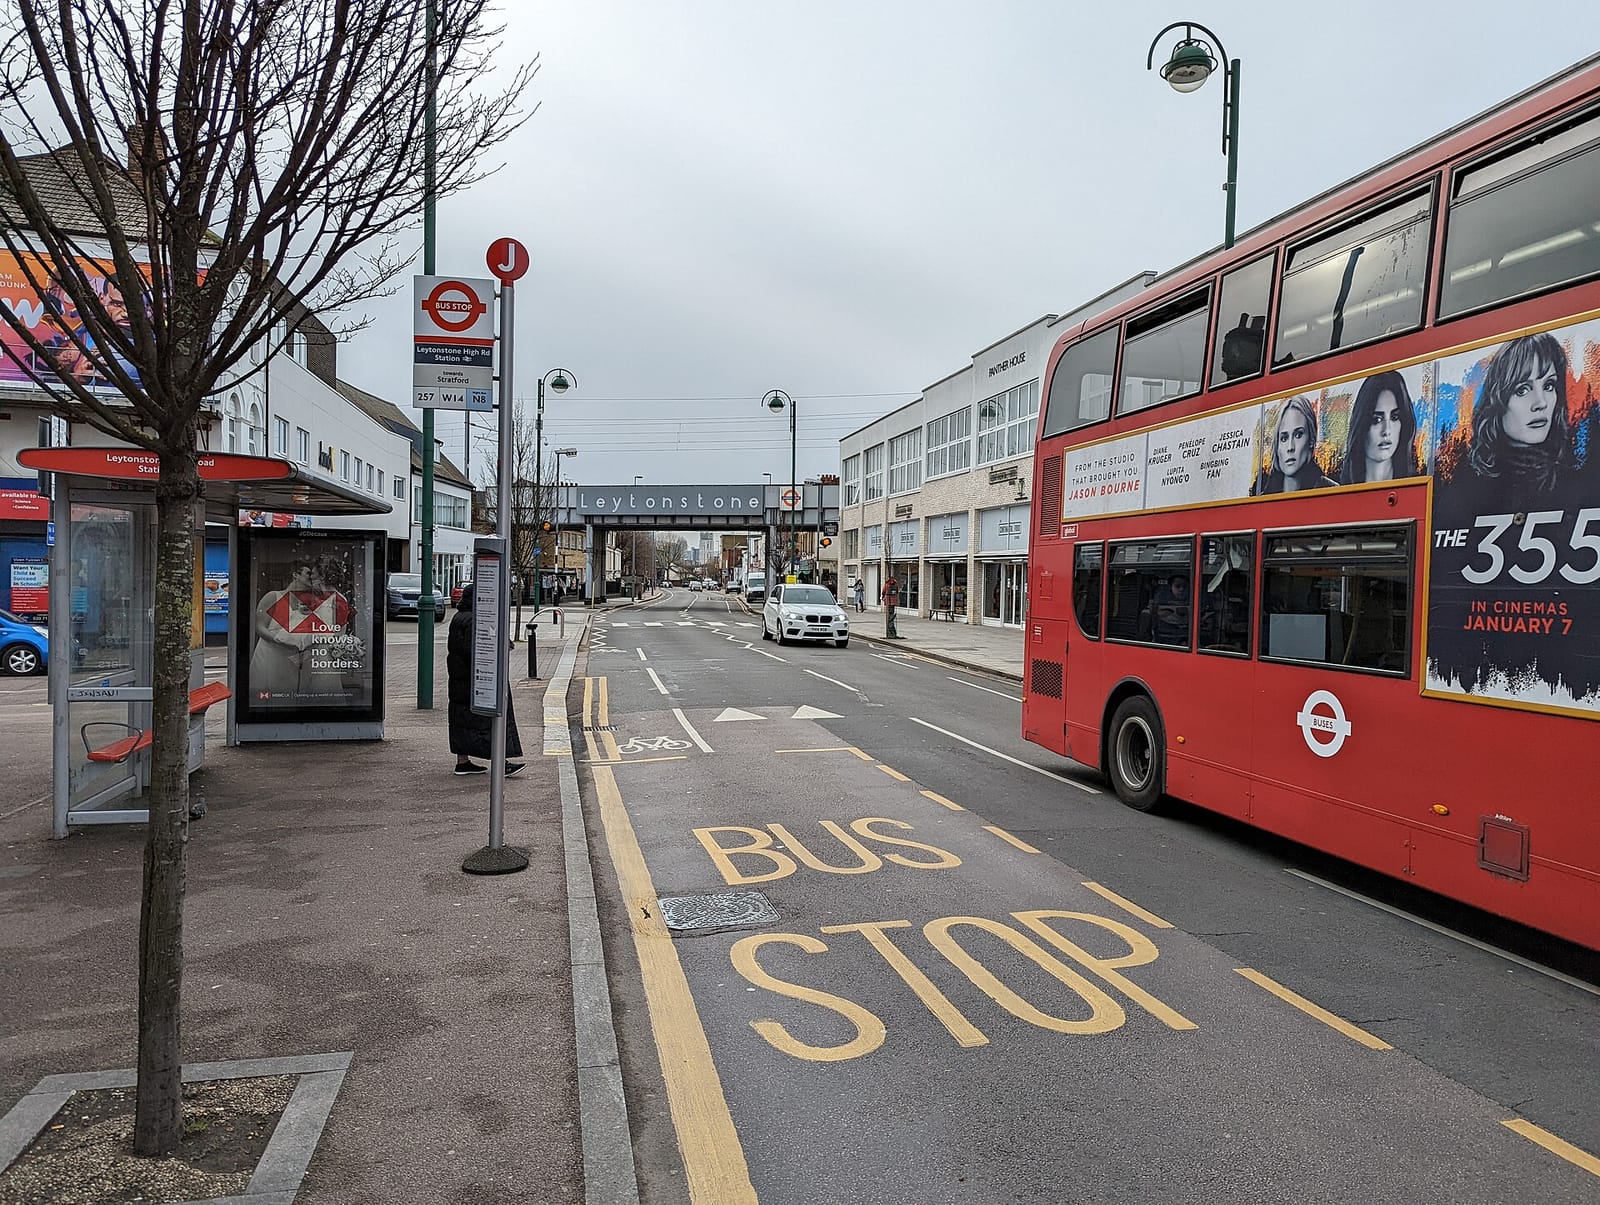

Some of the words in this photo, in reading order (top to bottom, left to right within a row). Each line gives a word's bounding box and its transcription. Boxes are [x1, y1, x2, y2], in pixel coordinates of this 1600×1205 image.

[497, 242, 516, 273] J
[435, 302, 451, 310] BUS
[452, 303, 473, 311] STOP
[416, 346, 462, 355] Leytonstone
[463, 348, 480, 357] High
[434, 354, 460, 362] Station
[988, 359, 1009, 378] PANTHER
[1009, 351, 1026, 368] HOUSE
[437, 375, 469, 384] Stratford
[417, 392, 435, 401] 257
[441, 393, 464, 402] W14
[472, 395, 487, 404] N8
[1219, 429, 1244, 441] JESSICA
[1153, 446, 1168, 456] DIANE
[1211, 437, 1250, 454] CHASTAIN
[1182, 447, 1201, 459] CRUZ
[197, 459, 215, 467] oad
[1075, 463, 1092, 472] FROM
[1094, 458, 1107, 468] THE
[1109, 453, 1135, 466] STUDIO
[1148, 453, 1173, 466] KRUGER
[1200, 458, 1229, 470] BINGBING
[138, 464, 160, 474] Stati
[1166, 466, 1185, 476] LUPITA
[1206, 468, 1221, 480] FAN
[1072, 476, 1087, 486] THAT
[1089, 470, 1121, 483] BROUGHT
[1123, 467, 1138, 477] YOU
[1068, 486, 1097, 501] JASON
[1100, 479, 1140, 496] BOURNE
[579, 492, 760, 513] Leytonstone
[1434, 528, 1470, 548] THE
[1460, 507, 1600, 585] 355
[1471, 601, 1487, 613] IN
[1493, 601, 1569, 616] CINEMAS
[311, 621, 341, 632] Love
[1463, 615, 1554, 635] JANUARY
[1561, 618, 1573, 636] 7
[311, 634, 353, 644] knows
[311, 648, 328, 656] no
[311, 658, 362, 669] borders.
[1313, 718, 1334, 730] BUSES
[692, 817, 963, 886] BUS
[729, 909, 1199, 1062] STOP
